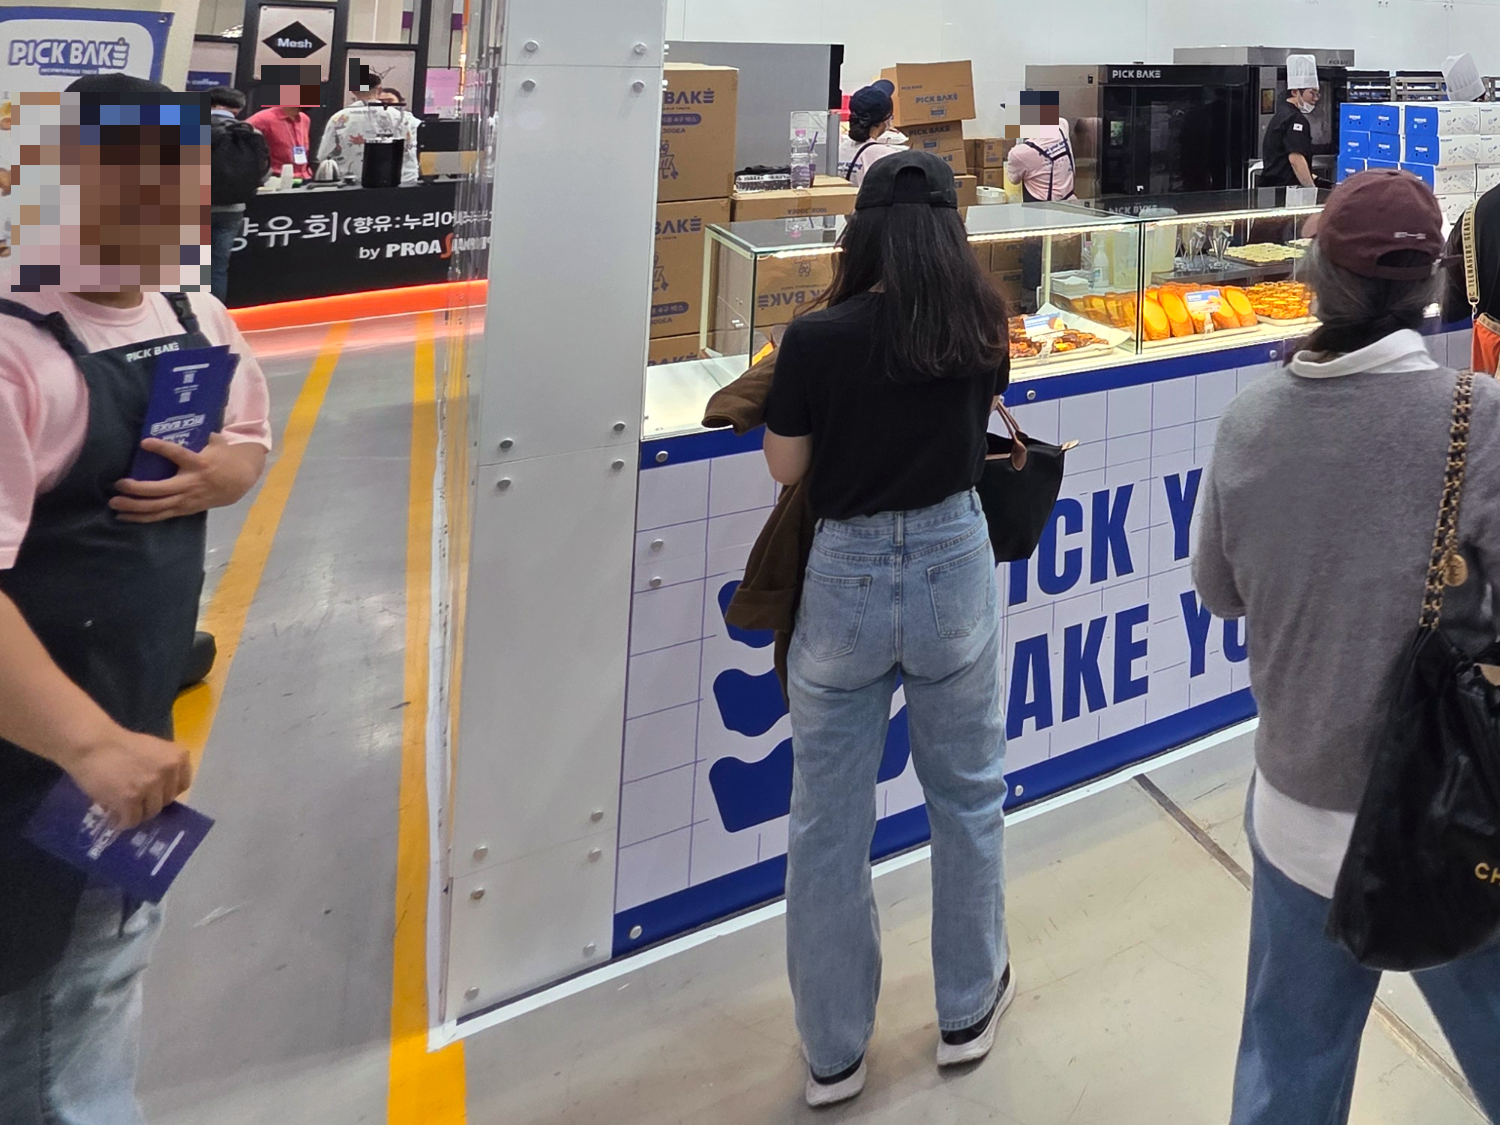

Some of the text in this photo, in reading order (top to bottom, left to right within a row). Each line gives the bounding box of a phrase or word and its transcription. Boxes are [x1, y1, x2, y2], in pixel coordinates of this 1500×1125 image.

[277, 37, 313, 49] Mesh
[10, 37, 128, 67] PICK BAKE
[1112, 69, 1161, 79] PICK BAKE
[663, 88, 714, 104] BAKE
[936, 93, 958, 102] BAKE
[909, 128, 927, 137] PICK
[359, 246, 380, 260] by
[1465, 244, 1475, 288] TEENAGERS
[125, 348, 151, 363] PICK
